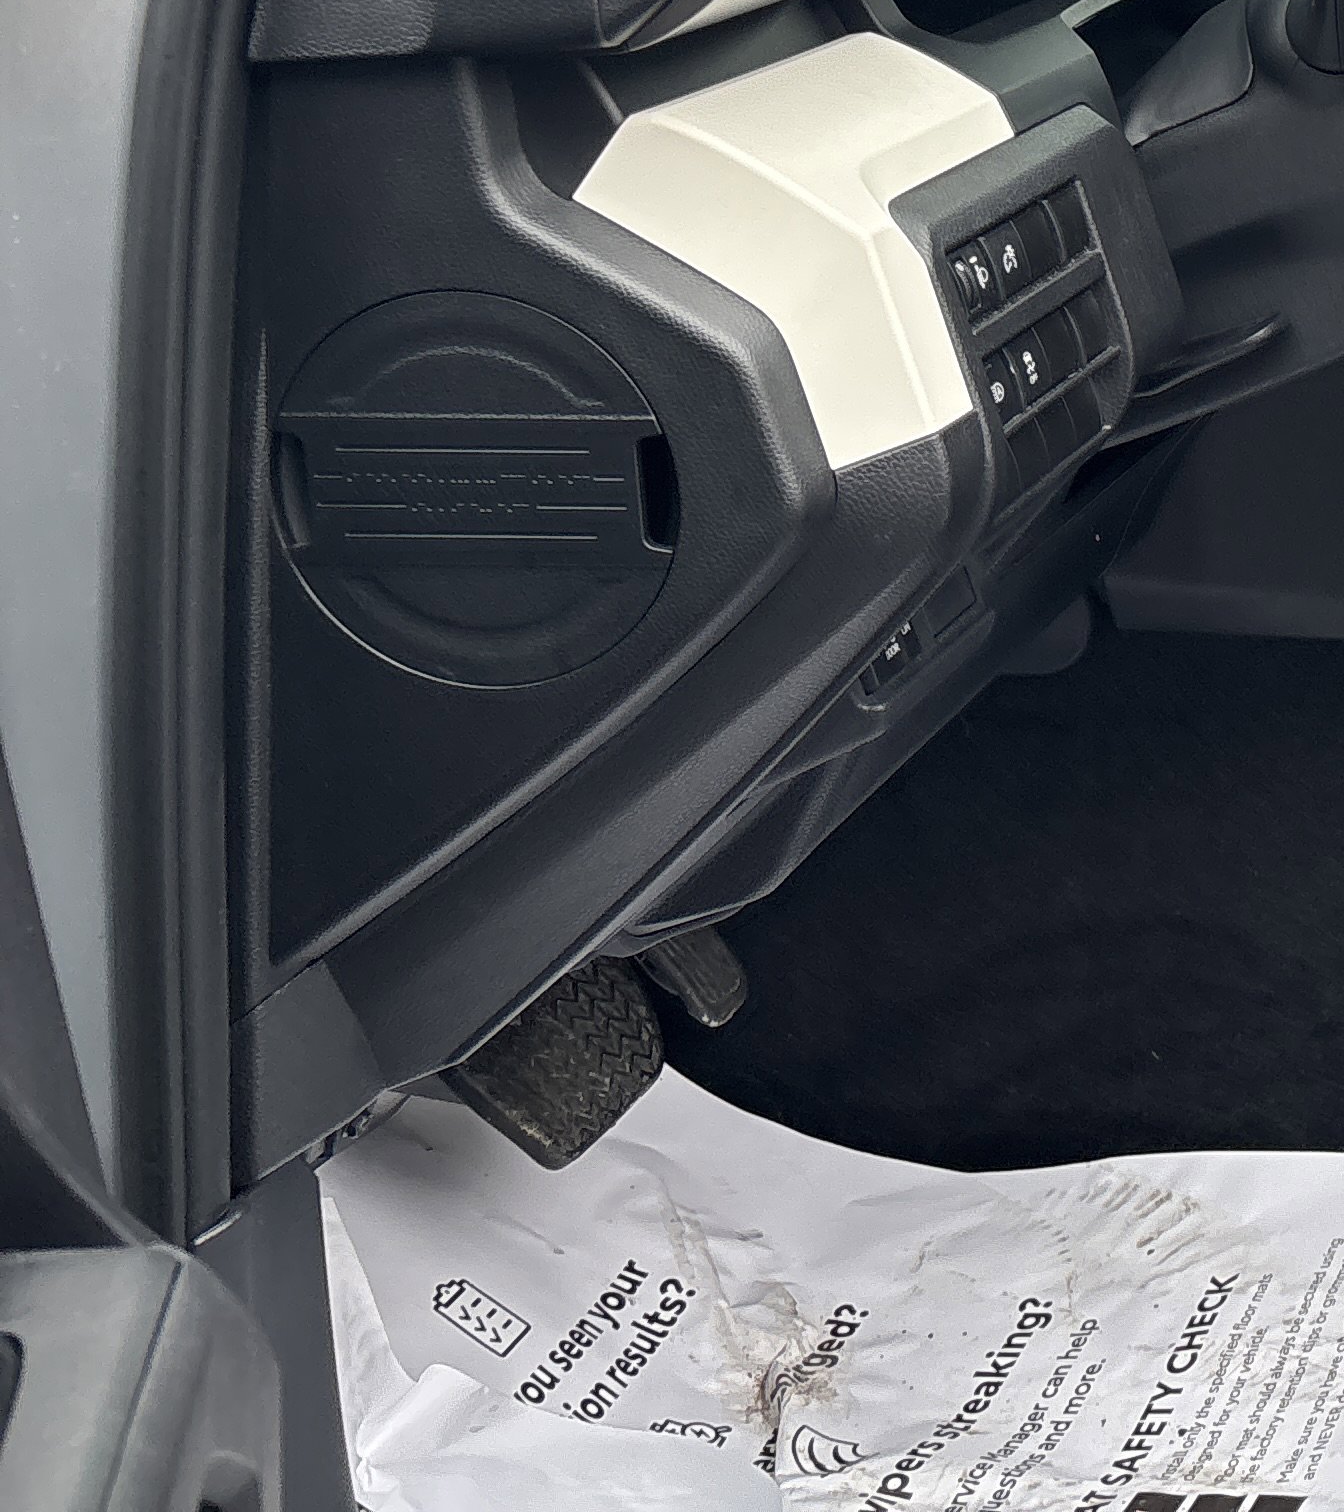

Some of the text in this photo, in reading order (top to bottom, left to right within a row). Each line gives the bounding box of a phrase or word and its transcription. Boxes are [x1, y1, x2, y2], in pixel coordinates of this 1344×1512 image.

[549, 1318, 605, 1372] seen
[588, 1259, 650, 1330] your
[606, 1278, 697, 1388] results?
[1056, 1318, 1100, 1361] help
[1236, 1427, 1256, 1450] mat
[1248, 1382, 1277, 1424] should
[1270, 1336, 1296, 1378] always
[1285, 1318, 1304, 1333] be
[1298, 1272, 1326, 1315] secured
[1320, 1238, 1344, 1269] using
[933, 1297, 1053, 1439] streaking?
[1042, 1364, 1072, 1398] can
[1099, 1381, 1184, 1487] SAFETY
[1167, 1272, 1241, 1374] CHECK
[1160, 1273, 1273, 1483] nstall only the specified floor mats
[1213, 1409, 1232, 1427] for
[1226, 1376, 1248, 1406] your
[1250, 1416, 1285, 1461] factory
[1276, 1357, 1309, 1413] retention
[1302, 1326, 1322, 1353] clips
[1316, 1311, 1328, 1324] or
[1311, 1390, 1329, 1414] you
[1319, 1355, 1343, 1388] have
[977, 1358, 1107, 1512] uestions and more.
[980, 1403, 1049, 1462] Manager
[1276, 1448, 1303, 1484] Make
[1298, 1416, 1317, 1445] sure
[1304, 1453, 1322, 1480] and
[1313, 1406, 1344, 1451] NEVER
